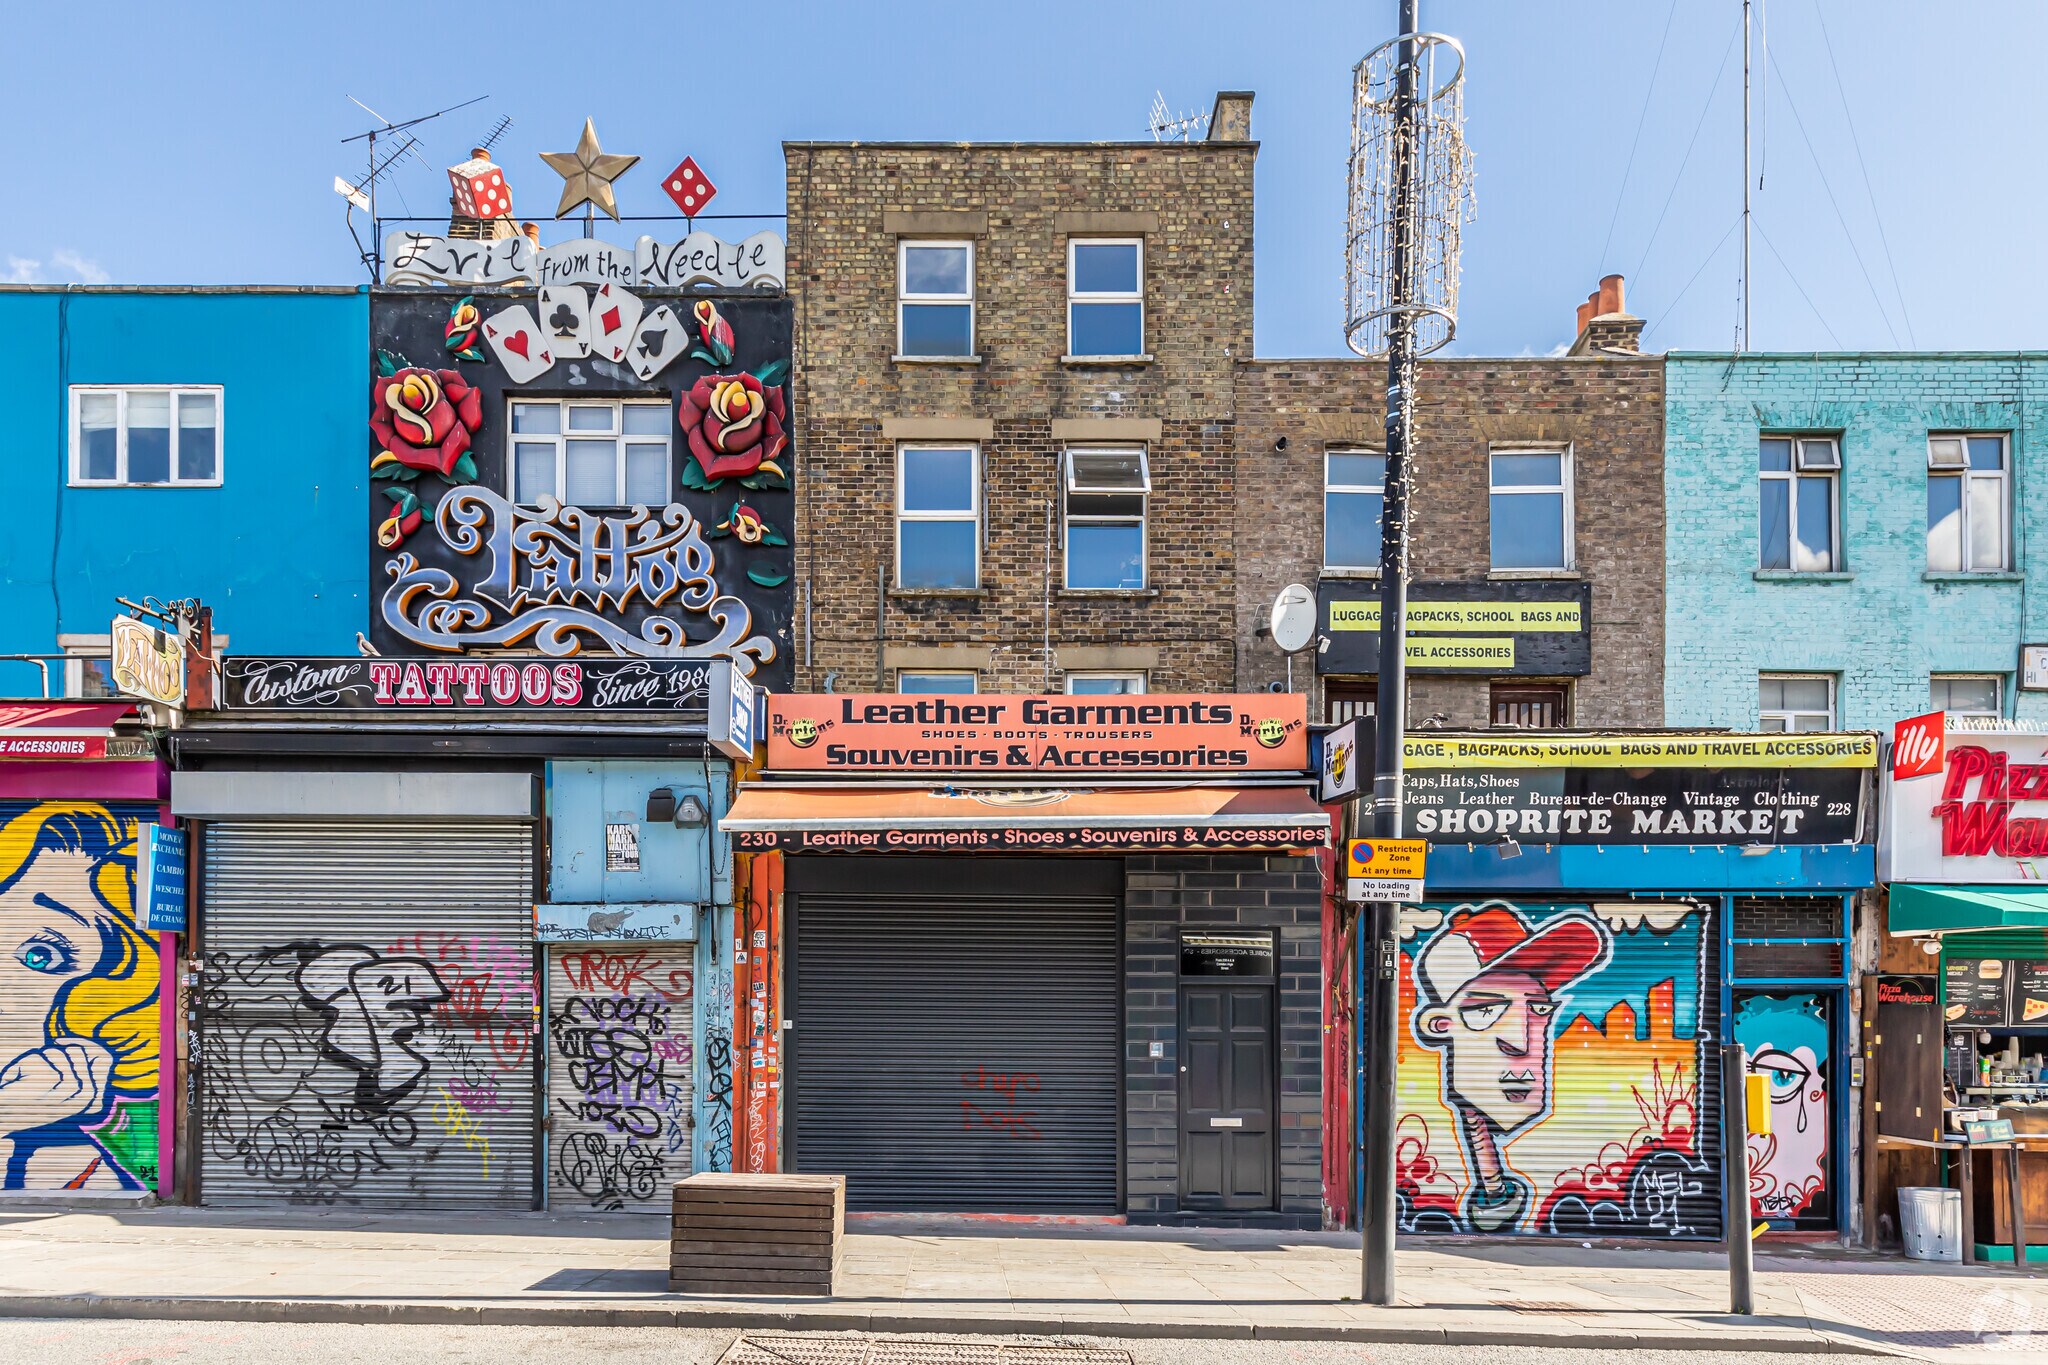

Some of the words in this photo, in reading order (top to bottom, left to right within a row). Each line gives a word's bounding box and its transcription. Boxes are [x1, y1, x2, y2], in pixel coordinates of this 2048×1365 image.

[393, 230, 527, 278] Evil
[538, 252, 589, 285] from
[597, 250, 632, 284] the
[640, 238, 768, 284] Needle
[1332, 610, 1381, 622] LUGGAG
[1405, 610, 1463, 623] AGPACKS,
[1466, 611, 1514, 622] SCHOOL
[1520, 611, 1552, 622] BAGS
[1556, 611, 1580, 622] AND
[1405, 646, 1427, 658] VEL
[1430, 646, 1511, 658] ACCESSORIES
[238, 661, 362, 706] Custom
[369, 661, 583, 707] TATTOOS
[588, 670, 662, 708] Since
[841, 698, 1006, 725] Leather
[1022, 699, 1234, 726] Garments
[772, 719, 835, 737] Martens
[921, 730, 977, 739] SHOES
[993, 730, 1047, 739] BOOTS
[1063, 731, 1153, 739] TROUSERS
[1240, 719, 1302, 737] Martens
[7, 740, 85, 753] ACCESSORIES
[1403, 743, 1444, 757] GAGE
[1459, 743, 1544, 758] BAGPACKS,
[1549, 743, 1612, 756] SCHOOL
[1621, 743, 1661, 756] BAGS
[1666, 743, 1698, 755] AND
[1702, 743, 1760, 755] TRAVEL
[1765, 742, 1872, 756] ACCESSORIES
[1896, 724, 1940, 772] illy
[826, 744, 999, 766] Souvenirs
[1005, 745, 1032, 766] &
[1038, 745, 1249, 766] Accessories
[1404, 792, 1444, 805] Jeans
[1459, 792, 1514, 805] Leather
[1529, 791, 1667, 807] Bureau-de-Change
[1683, 791, 1740, 807] Vintage
[1754, 791, 1820, 807] Clothing
[1827, 802, 1851, 816] 228
[1416, 809, 1612, 834] SHOPRITE
[1631, 809, 1805, 834] MARKET
[159, 832, 183, 845] MONEY
[740, 831, 778, 847] 230
[802, 831, 880, 847] Leather
[886, 829, 988, 846] Garments
[1005, 828, 1064, 845] Shoes
[1081, 828, 1178, 843] Souvenirs
[1183, 828, 1198, 842] &
[1204, 826, 1325, 842] Accessories
[1378, 845, 1423, 853] Restricted
[156, 864, 185, 876] CAMBIO
[1378, 882, 1410, 890] loading
[156, 903, 184, 914] BUREAU
[151, 913, 160, 922] DE
[161, 914, 186, 924] CHANG
[1878, 983, 1902, 993] Pizza
[1878, 992, 1934, 1004] Warehouse
[1642, 1170, 1702, 1196] MEL
